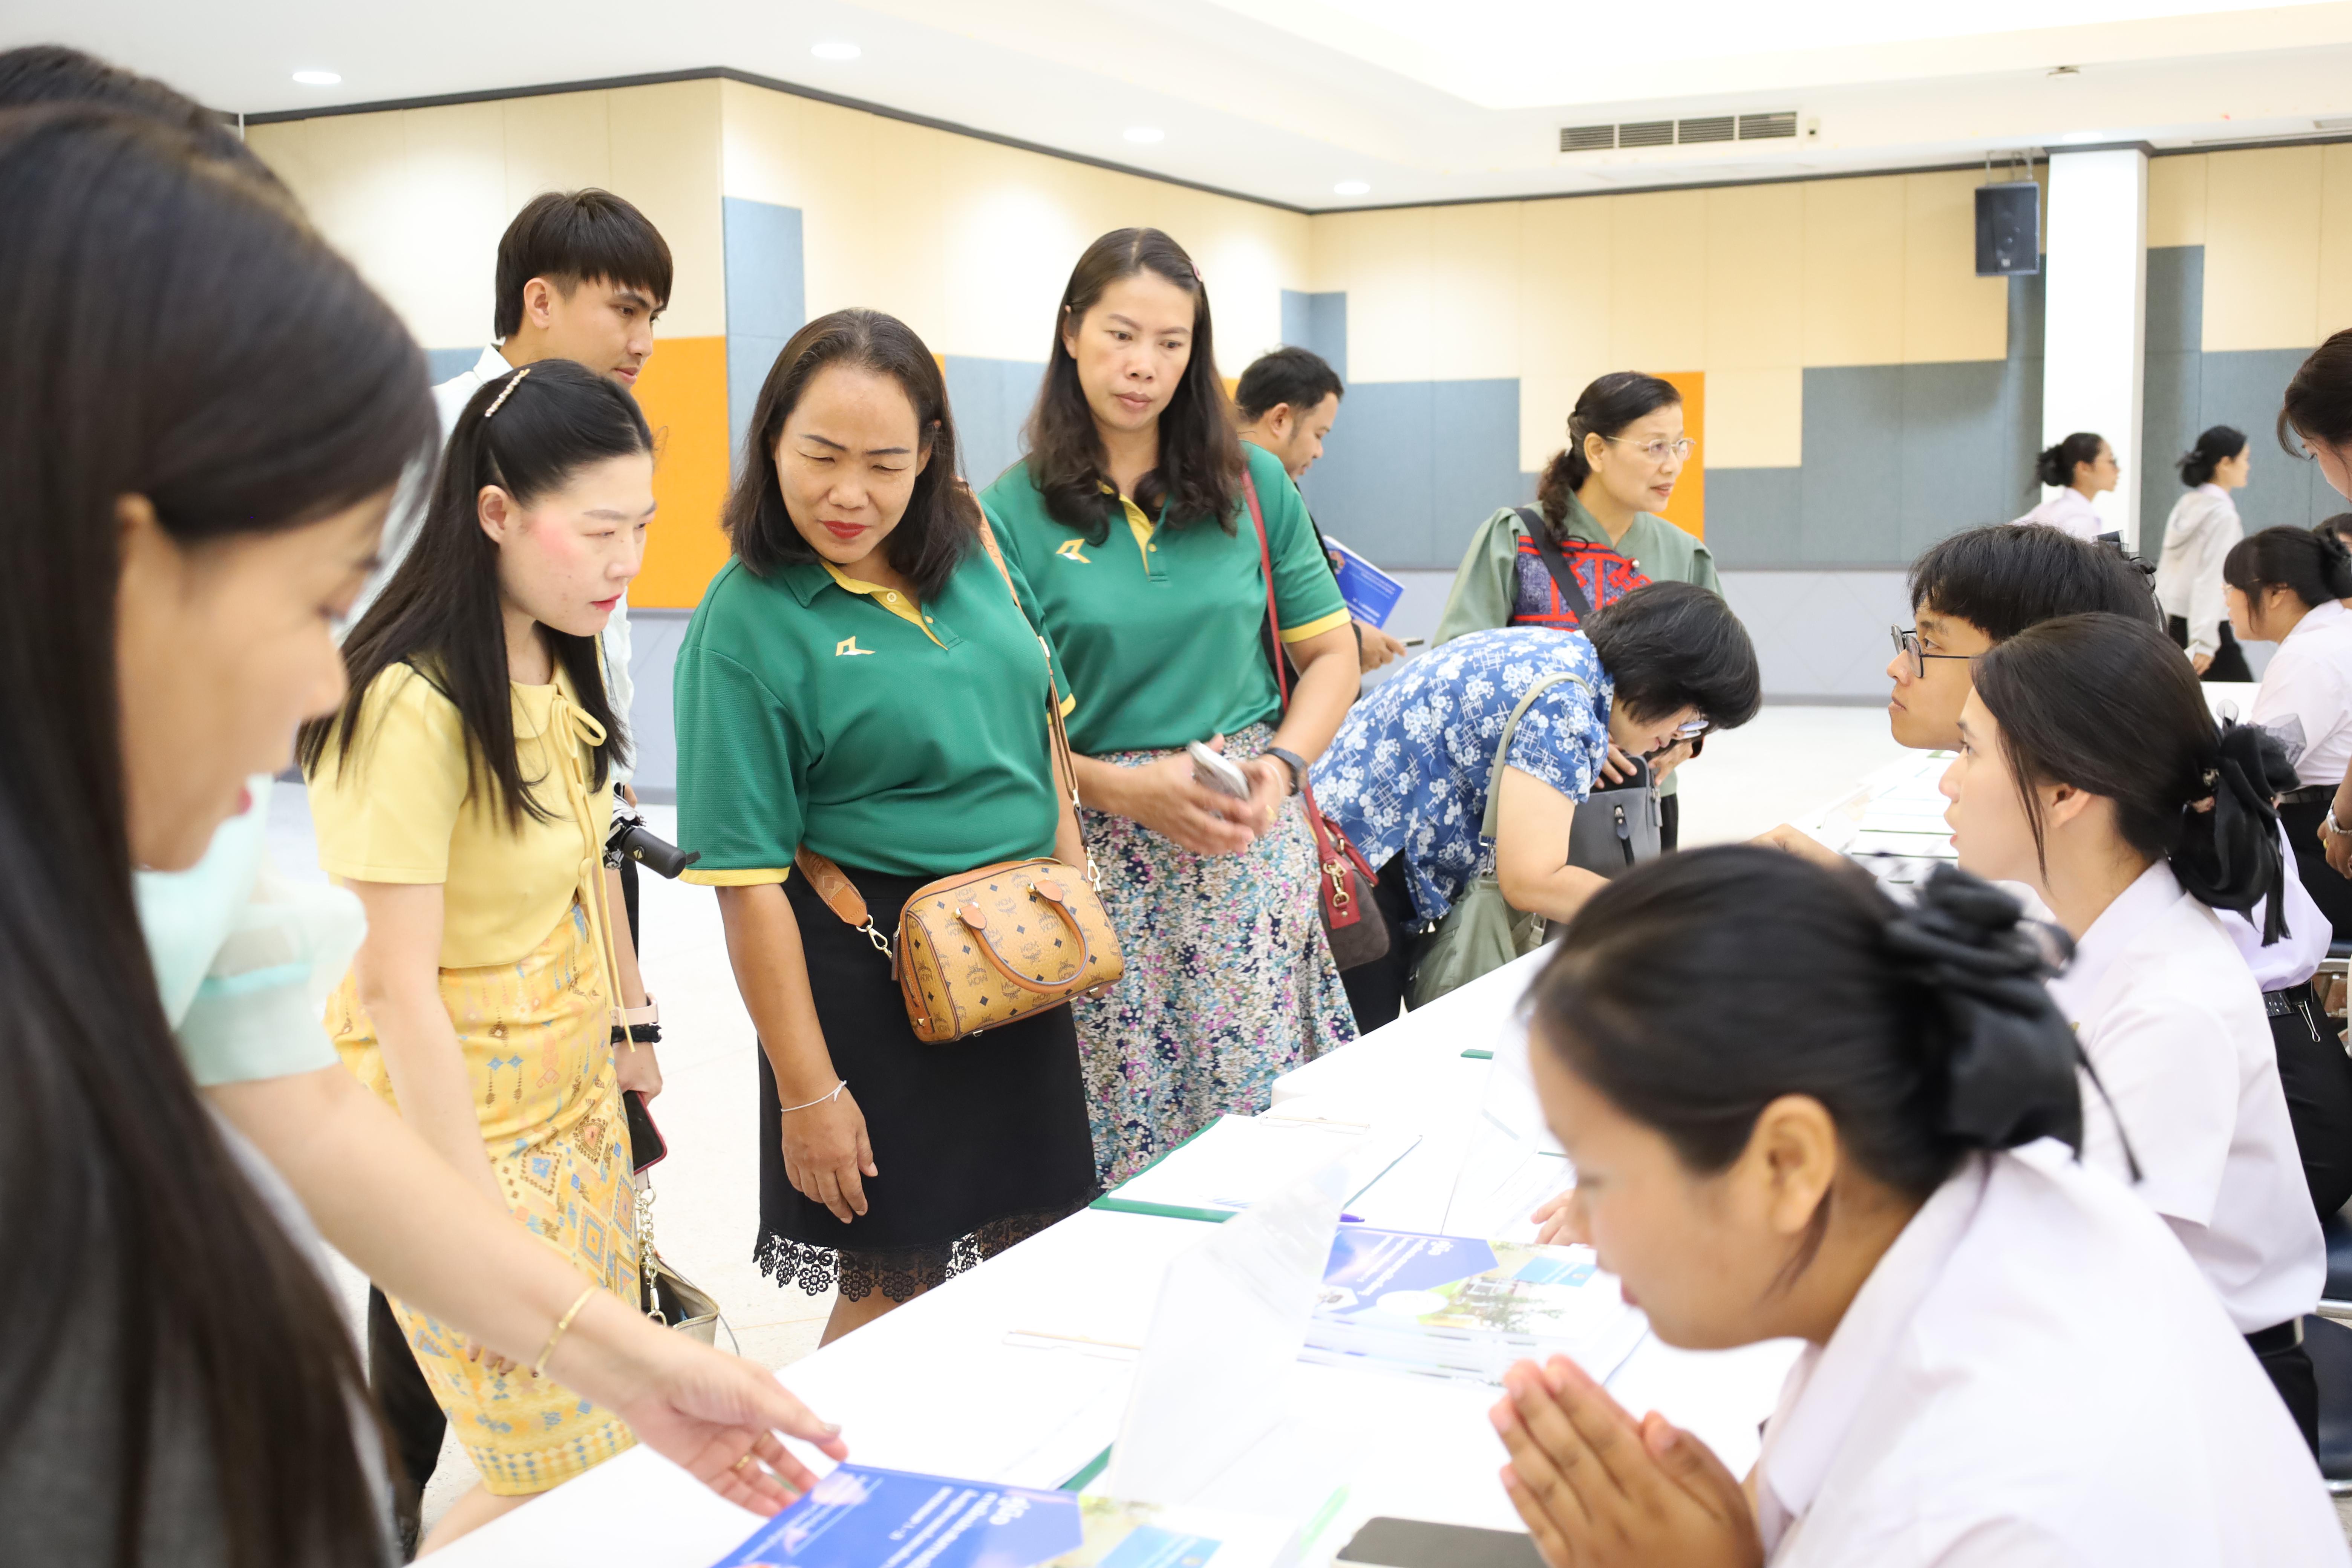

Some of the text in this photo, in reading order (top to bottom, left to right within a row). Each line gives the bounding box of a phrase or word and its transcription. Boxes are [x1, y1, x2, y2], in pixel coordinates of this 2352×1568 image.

[955, 887, 975, 898] MCM
[995, 897, 1014, 908] MCM
[1019, 940, 1040, 953] MCM
[967, 974, 988, 987] MCM
[1001, 980, 1015, 991] MC
